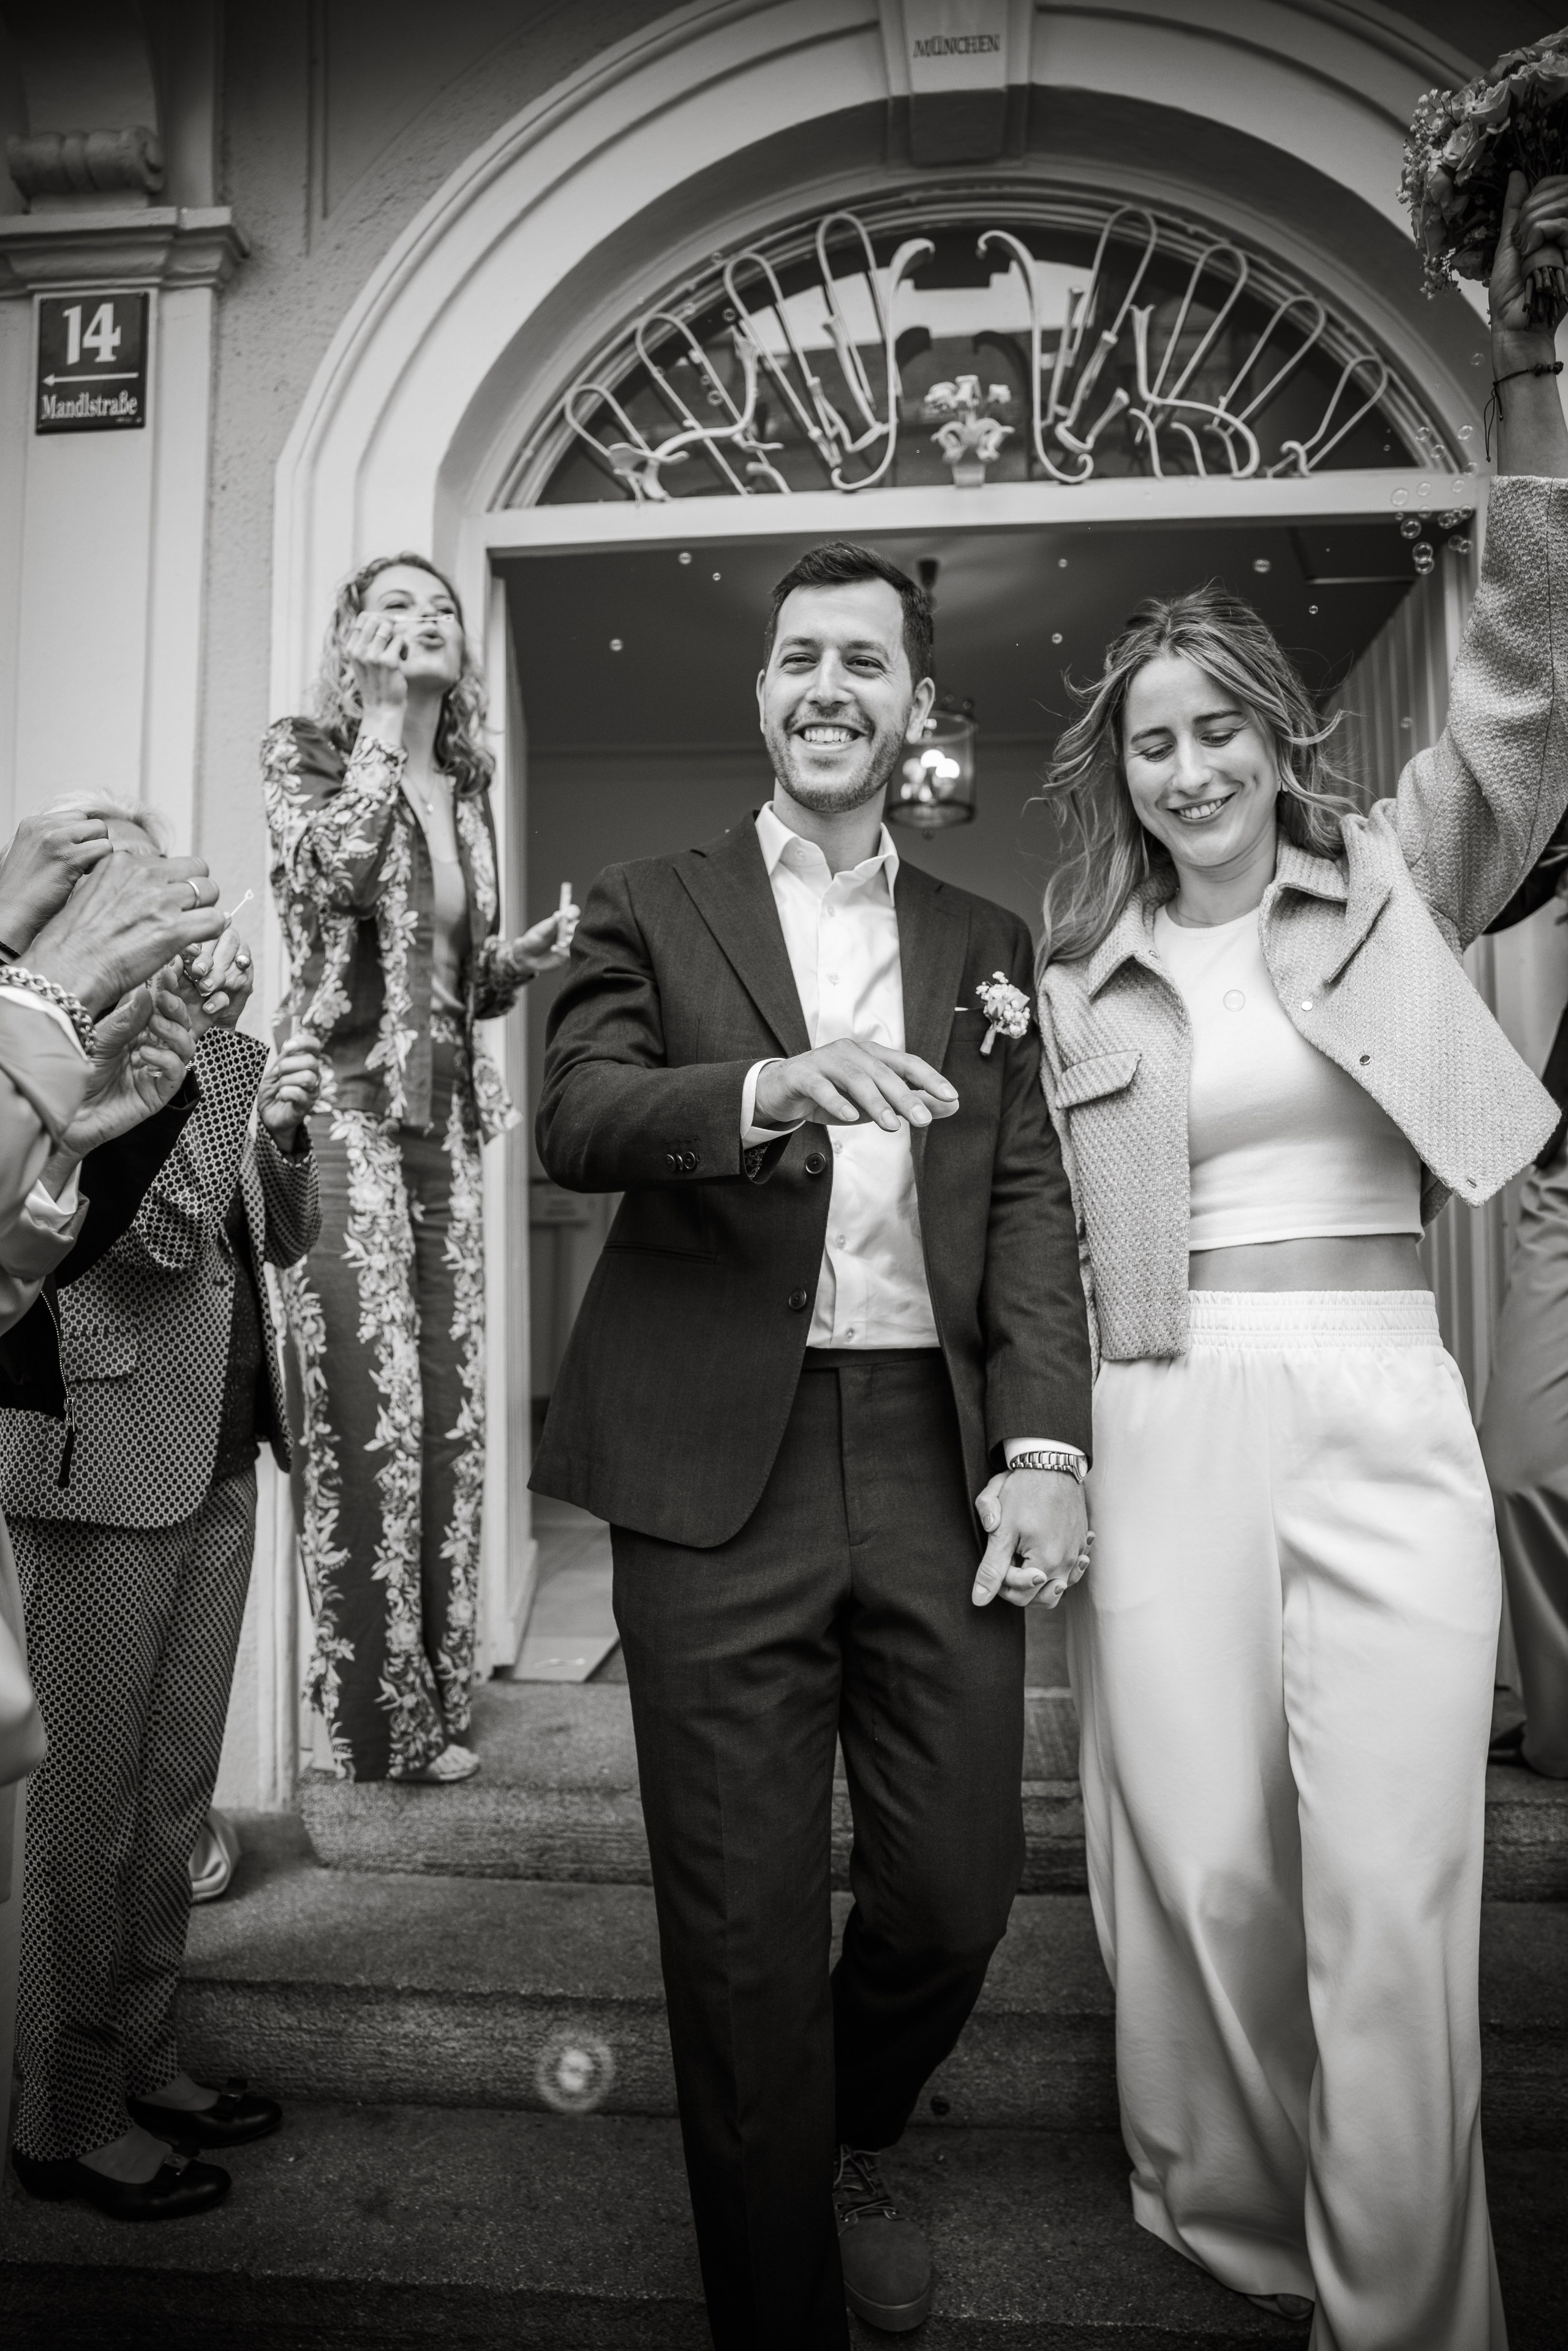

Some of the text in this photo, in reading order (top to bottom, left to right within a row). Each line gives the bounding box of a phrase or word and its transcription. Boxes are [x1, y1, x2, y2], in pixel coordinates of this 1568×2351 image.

[913, 34, 1001, 58] MÜNCHEN
[62, 302, 121, 365] 14
[40, 390, 138, 420] Mandlstraße
